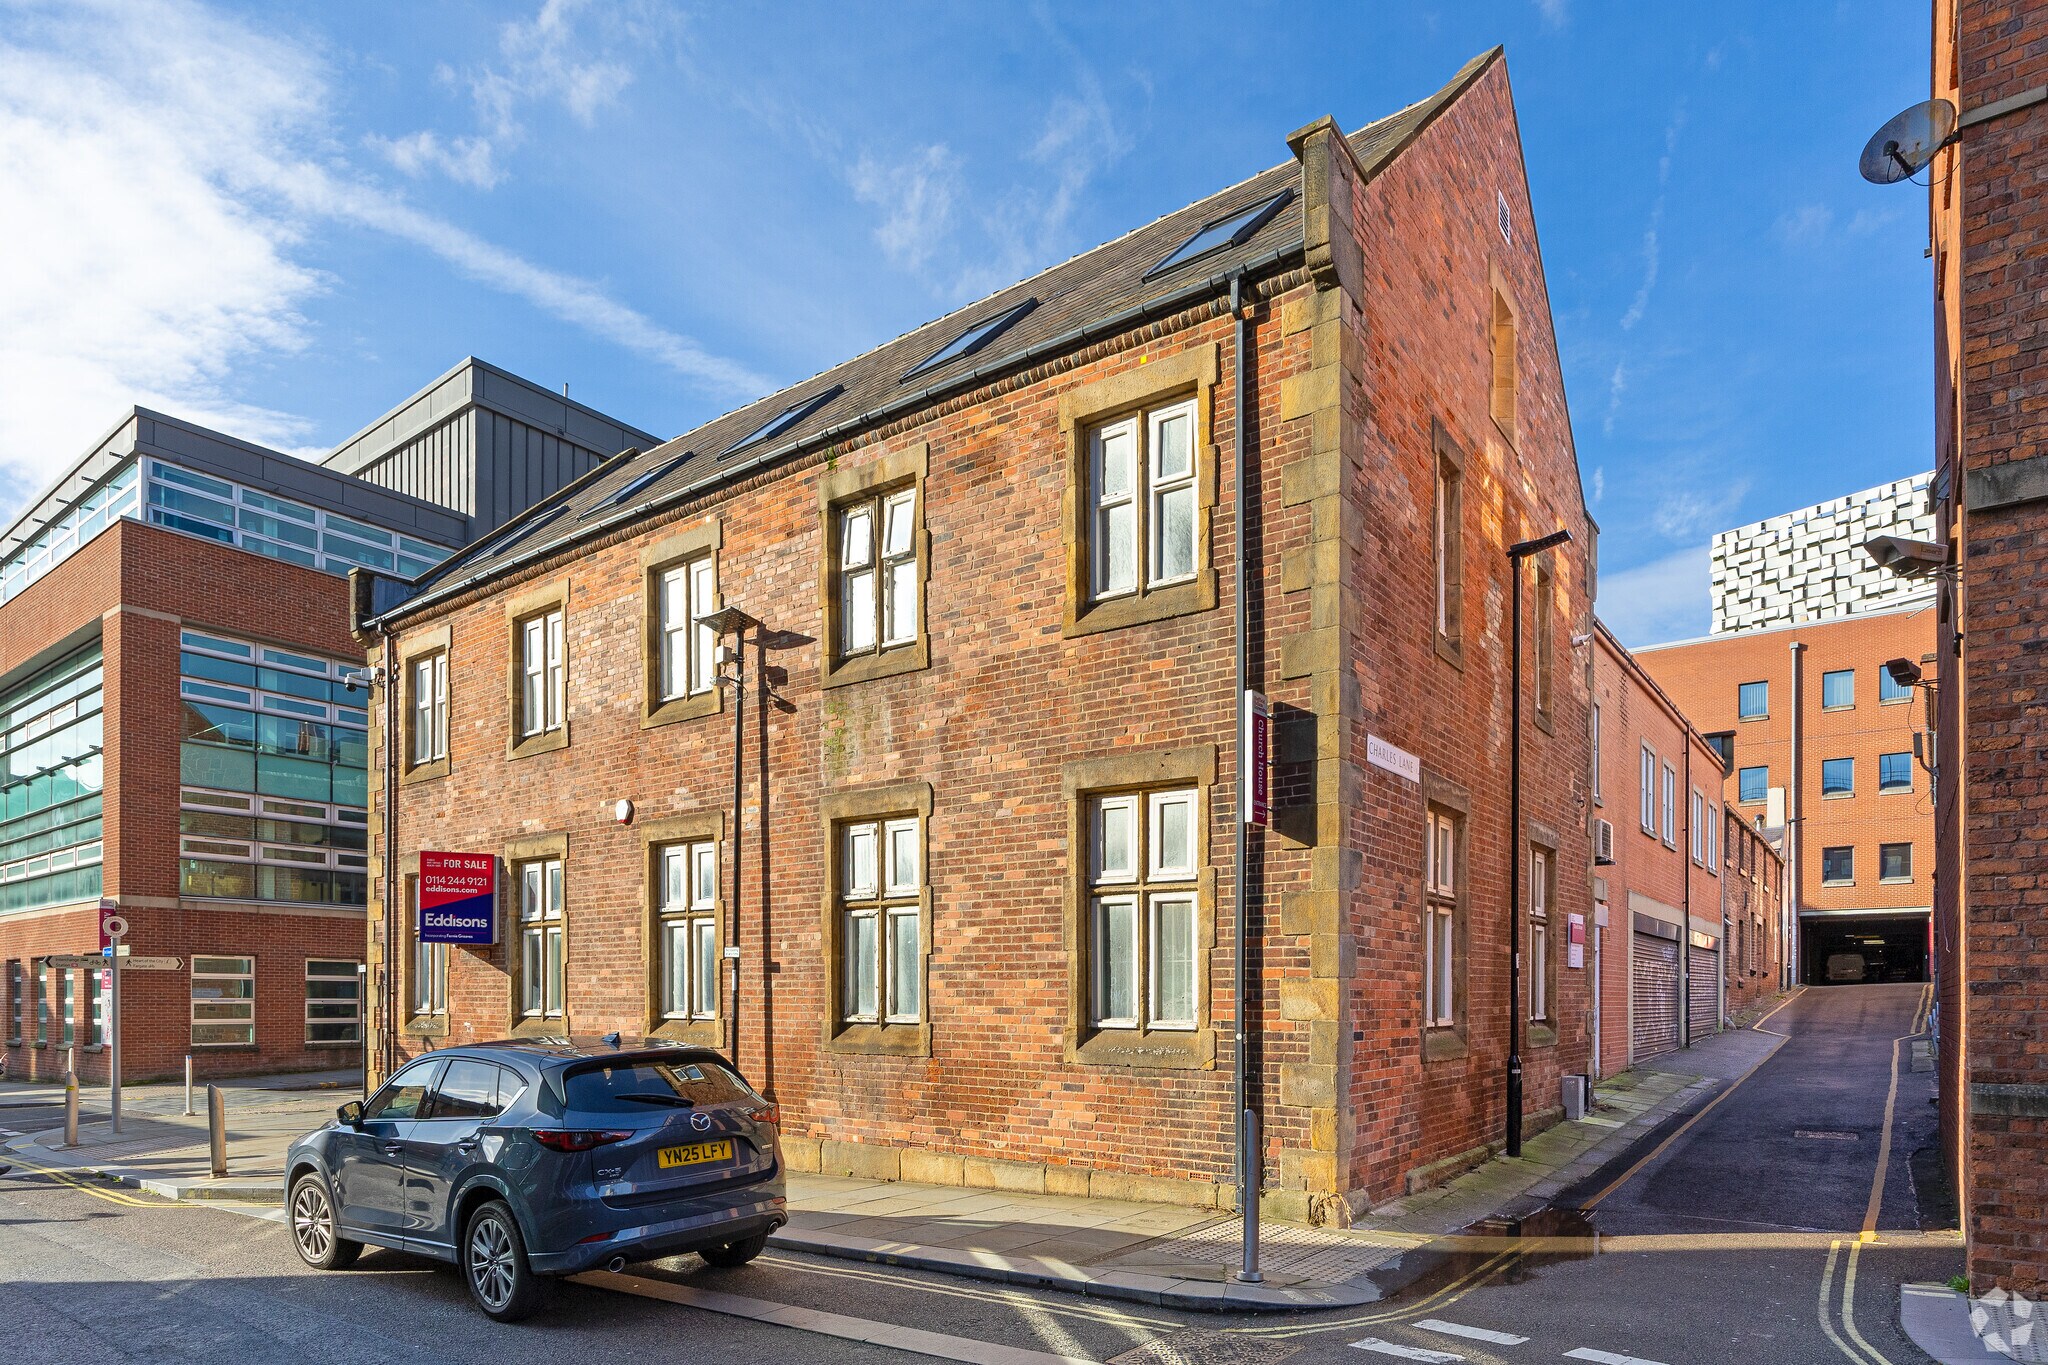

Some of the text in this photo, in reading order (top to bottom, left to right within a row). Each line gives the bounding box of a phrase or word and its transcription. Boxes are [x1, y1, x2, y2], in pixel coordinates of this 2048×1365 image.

[1369, 742, 1413, 773] CHARLES LANE
[443, 859, 461, 869] FOR
[464, 860, 487, 870] SALE
[425, 875, 487, 886] 0114 244 9121
[425, 884, 478, 894] eddisons.com
[425, 913, 488, 928] Eddisons
[664, 1142, 726, 1165] YN25 LFY
[597, 1166, 622, 1176] CX-5
